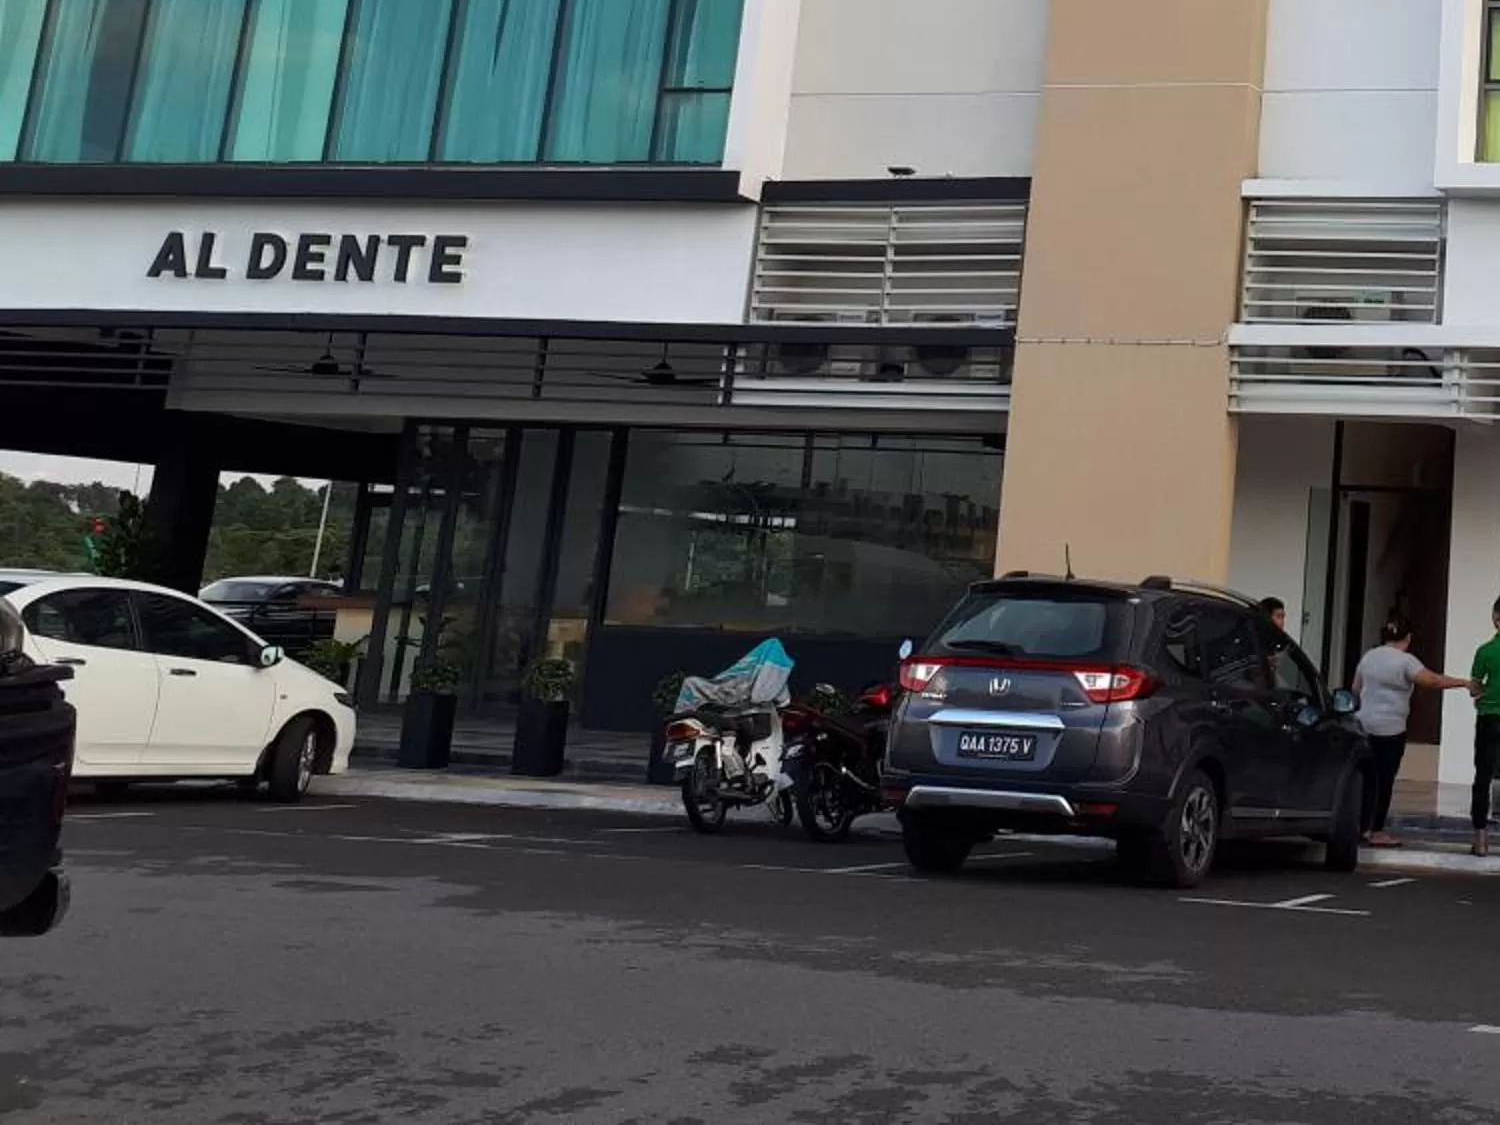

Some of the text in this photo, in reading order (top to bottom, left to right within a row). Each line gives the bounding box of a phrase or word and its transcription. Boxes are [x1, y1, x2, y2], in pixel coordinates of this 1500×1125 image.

[146, 232, 468, 283] AL DENTE
[960, 735, 1033, 754] QAA 1375 V
